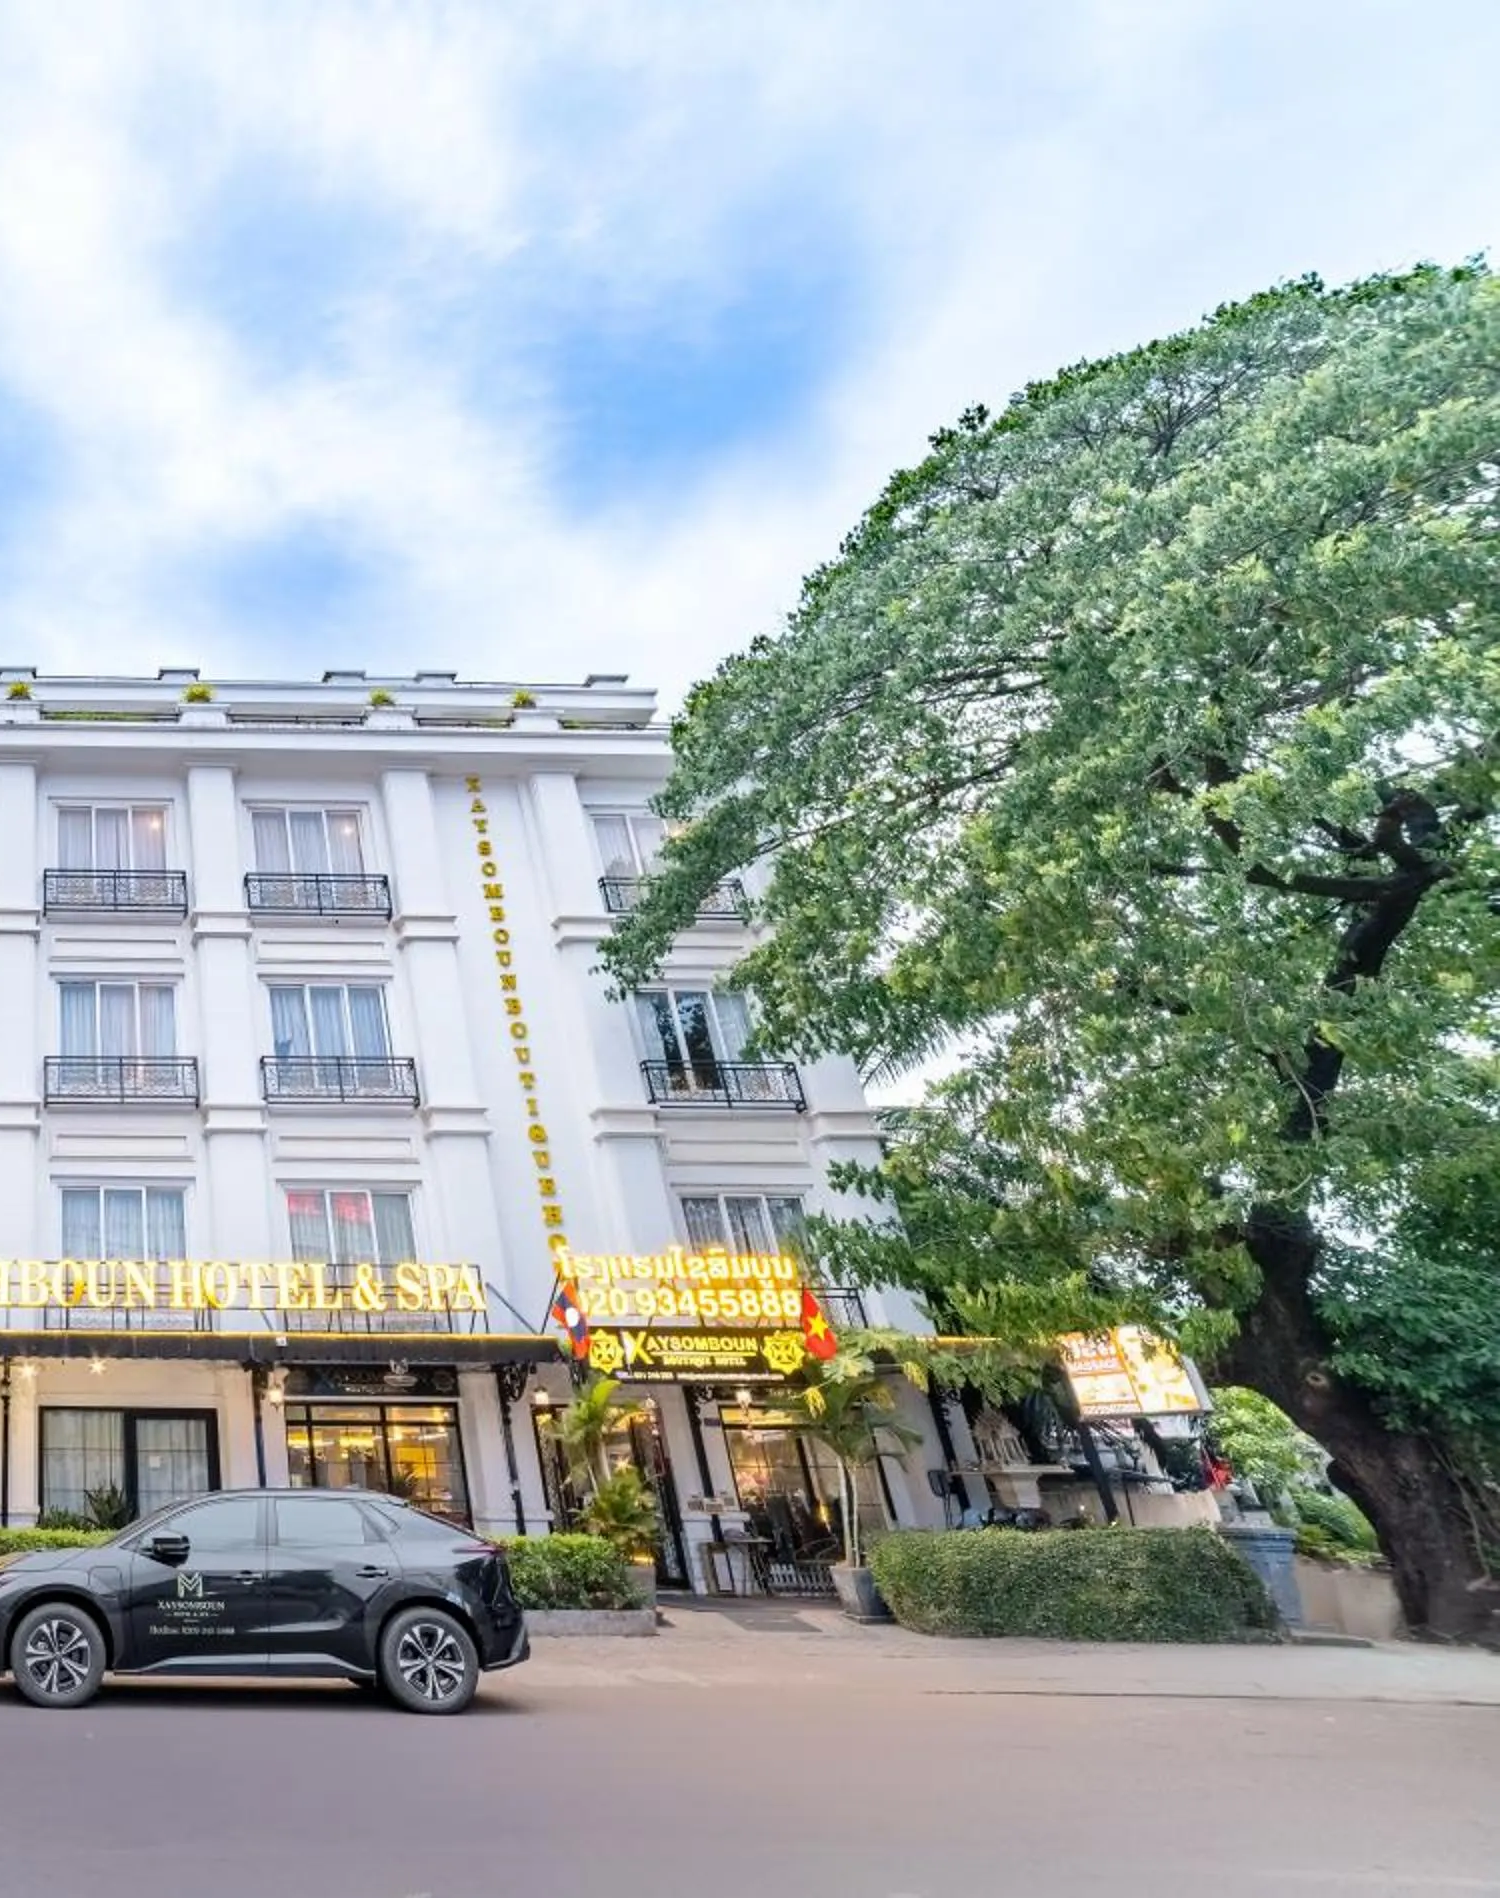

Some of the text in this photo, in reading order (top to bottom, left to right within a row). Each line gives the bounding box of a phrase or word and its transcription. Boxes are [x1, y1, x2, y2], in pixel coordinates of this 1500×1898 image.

[167, 1260, 343, 1311] HOTEL
[352, 1262, 390, 1312] &
[395, 1261, 488, 1312] SPA
[634, 1288, 803, 1319] 93455888
